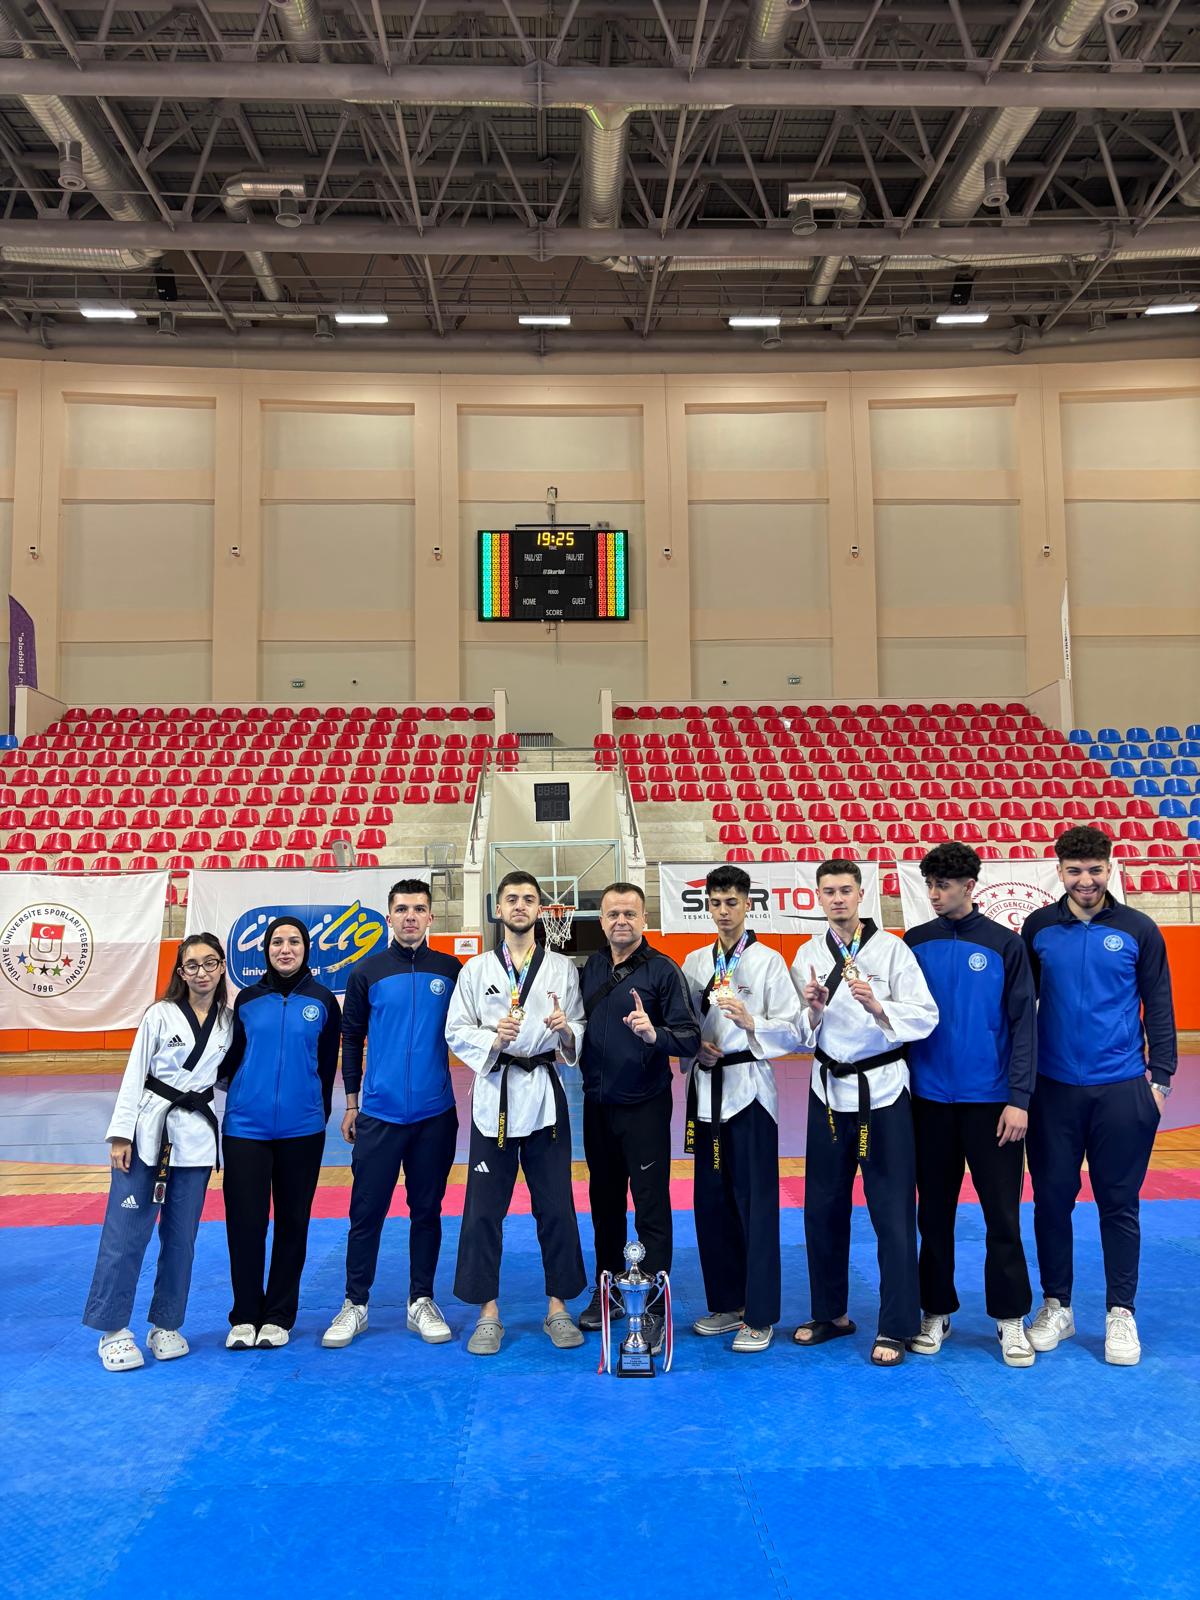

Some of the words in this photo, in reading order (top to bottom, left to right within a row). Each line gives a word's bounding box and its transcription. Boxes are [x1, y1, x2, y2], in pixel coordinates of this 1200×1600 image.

[537, 532, 574, 546] 19:25
[522, 598, 537, 606] HOME
[571, 597, 586, 605] GUEST
[2, 909, 42, 945] ÜNİVERSİTE
[44, 908, 82, 928] SPORLARI
[2, 947, 21, 981] TÜRKİYE
[65, 928, 89, 985] FEDERASYONU
[32, 983, 54, 993] 1996
[713, 1137, 721, 1170] TÜRKİYE
[859, 1124, 869, 1157] TÜRKİYE
